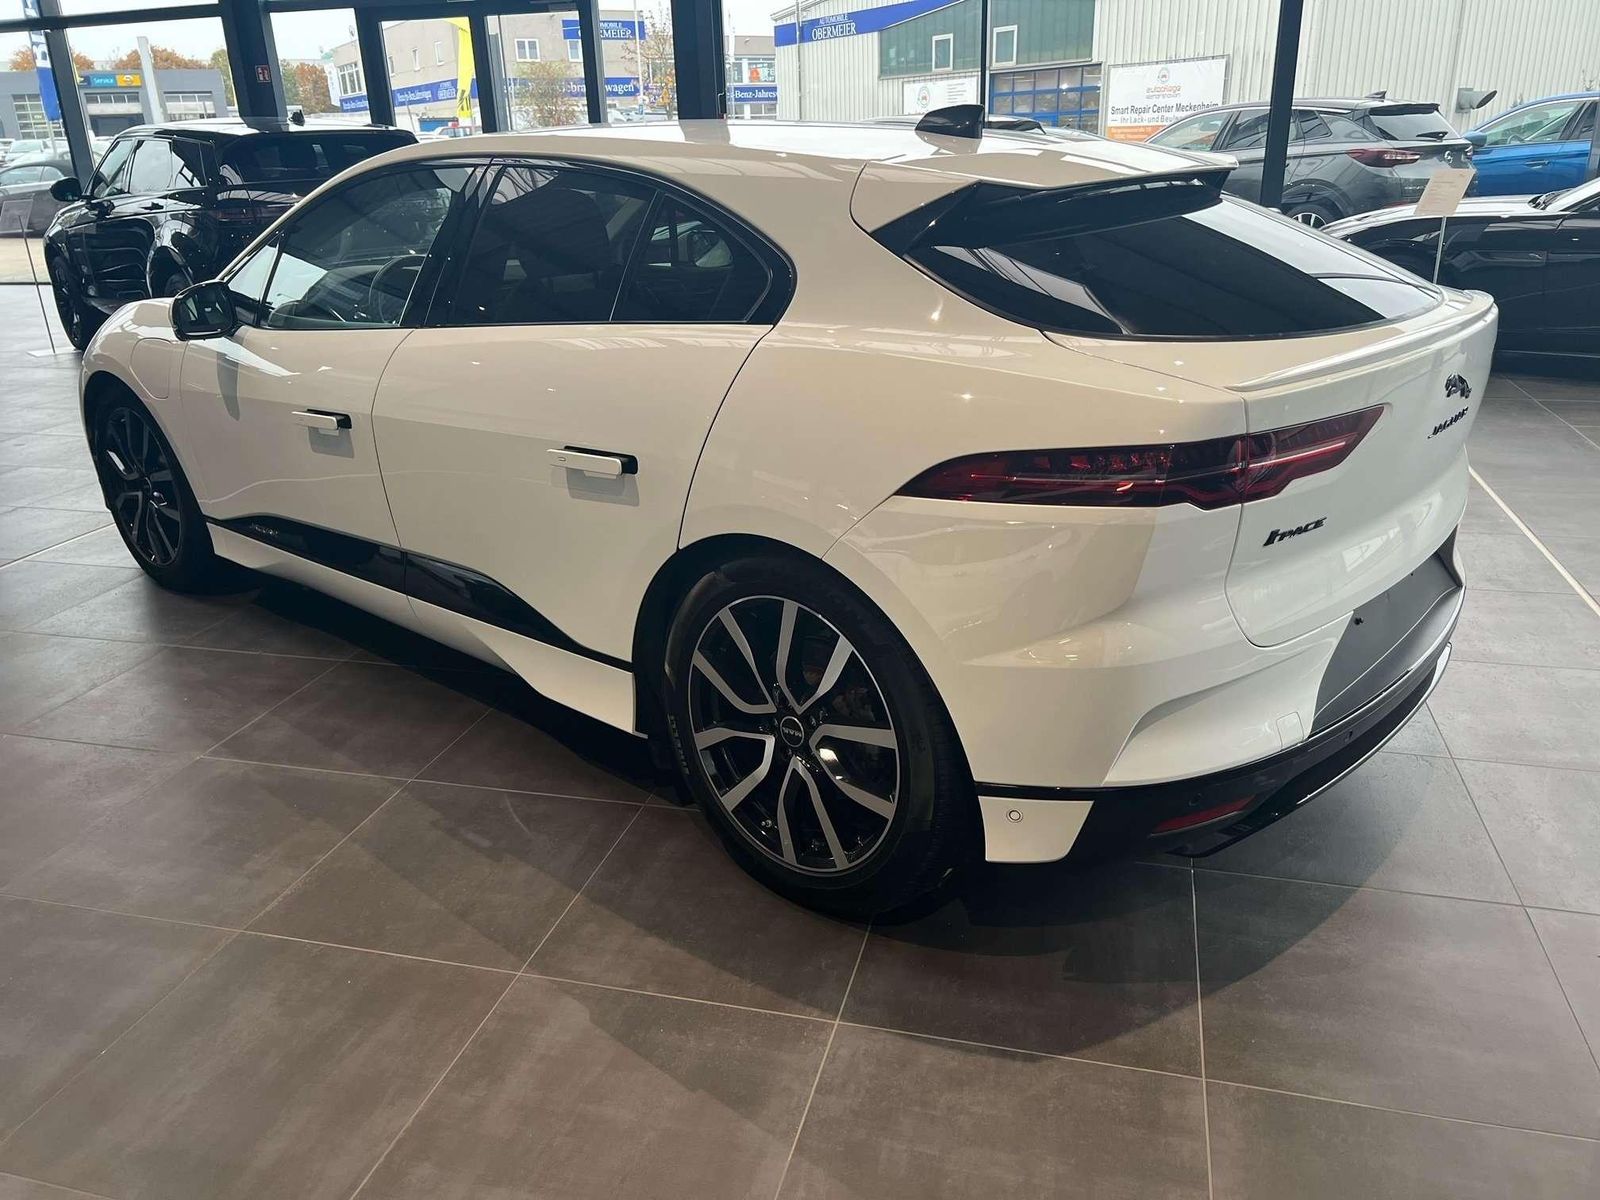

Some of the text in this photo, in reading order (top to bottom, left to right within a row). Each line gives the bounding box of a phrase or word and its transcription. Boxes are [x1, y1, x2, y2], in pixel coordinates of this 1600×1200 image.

[811, 22, 857, 41] OBERMEIER
[1111, 101, 1219, 116] Smart Repair Center Meckenheim
